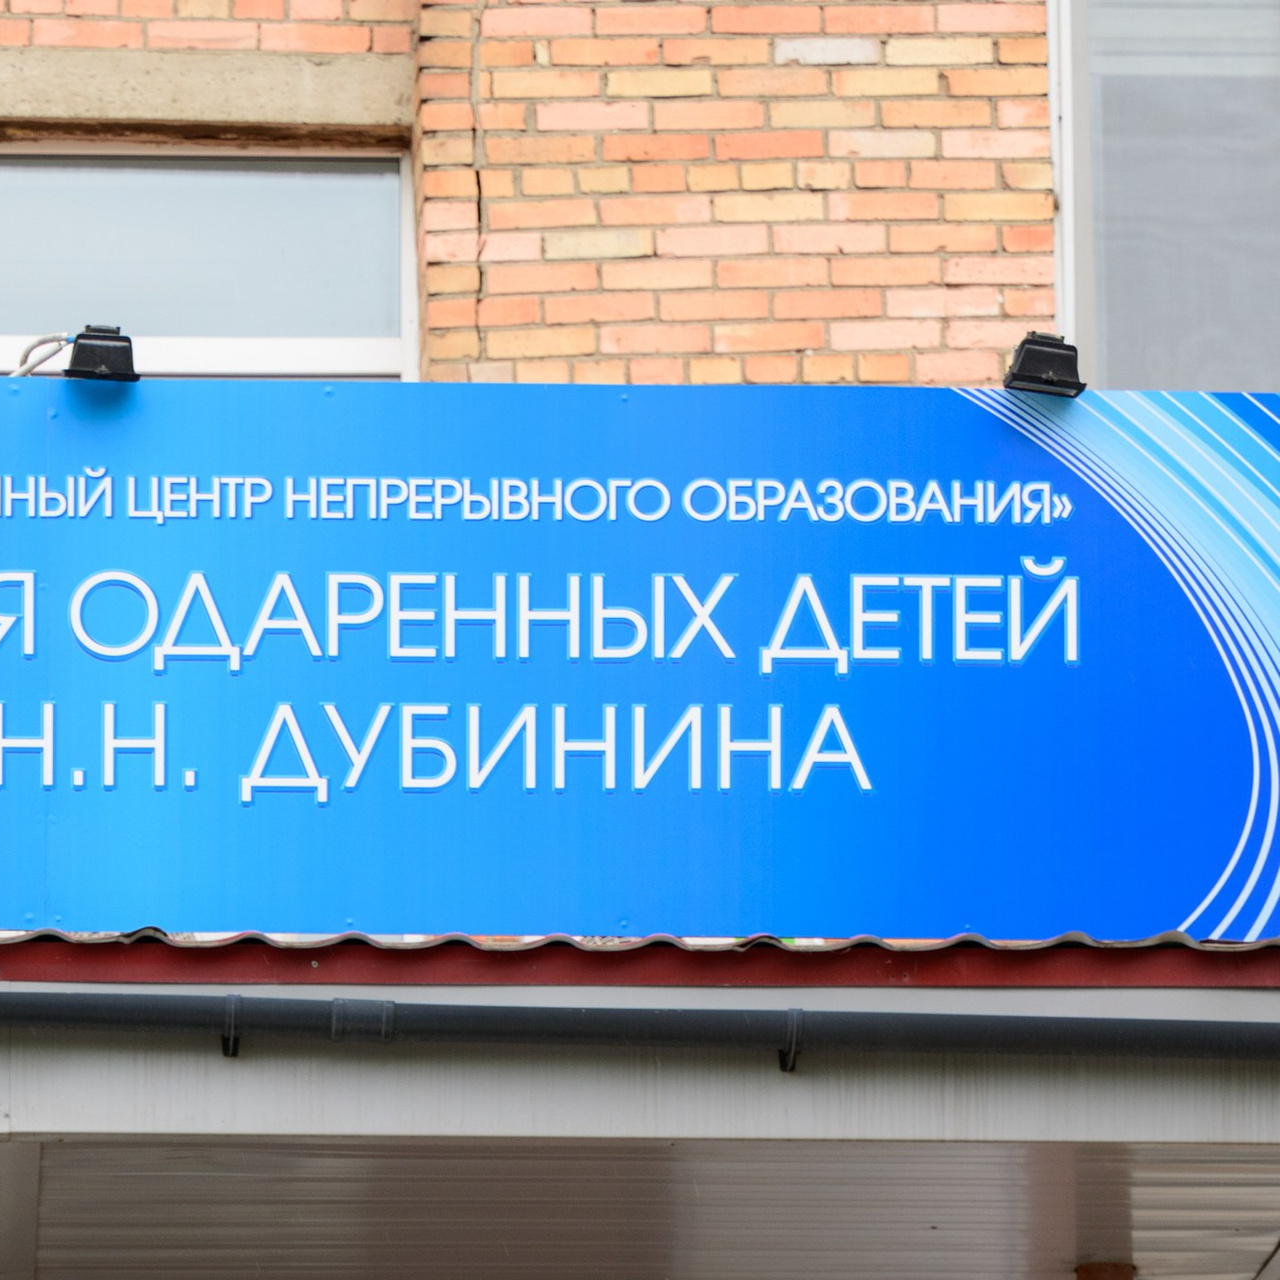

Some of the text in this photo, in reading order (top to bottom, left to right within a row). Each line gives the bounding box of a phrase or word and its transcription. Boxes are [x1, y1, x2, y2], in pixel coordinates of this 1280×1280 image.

[128, 477, 272, 524] ЦЕНТР
[286, 477, 671, 521] НЕПРЕРЫВНОГО
[684, 478, 1073, 524] ОБРАЗОВАНИЯ»
[69, 570, 737, 672] ОДАРЕННЫХ
[760, 556, 1079, 676] ДЕТЕЙ
[239, 703, 873, 804] ДУБИНИНА
